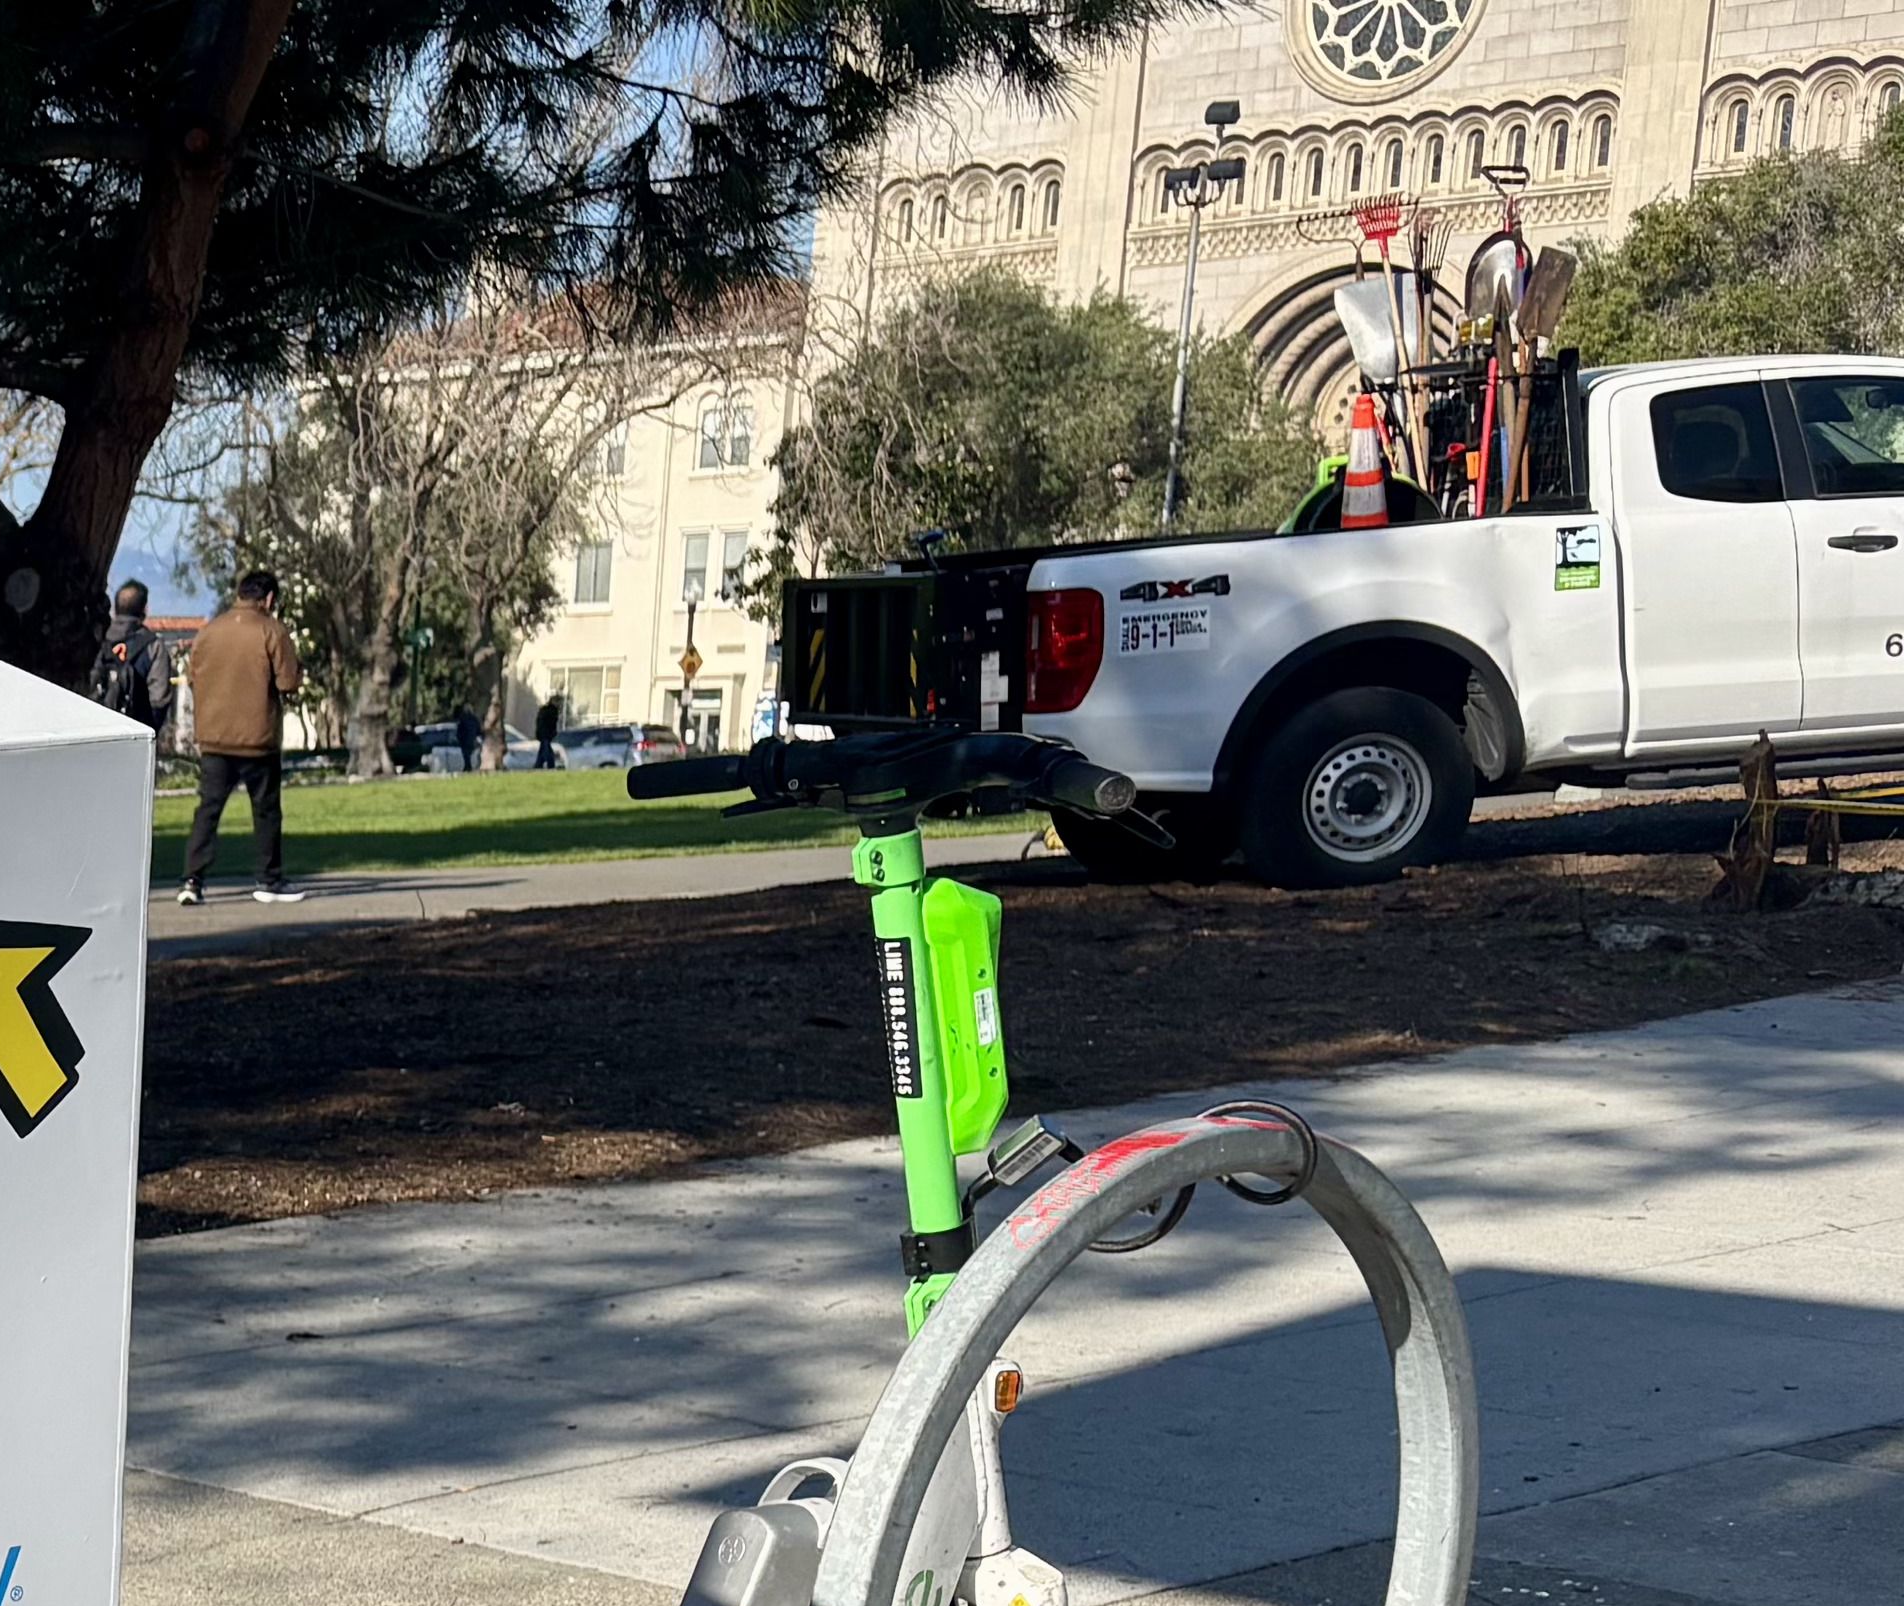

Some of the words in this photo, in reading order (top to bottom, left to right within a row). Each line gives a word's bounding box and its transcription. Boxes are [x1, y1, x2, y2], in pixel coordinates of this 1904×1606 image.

[1131, 622, 1174, 650] 9-1-1
[1885, 633, 1904, 657] 6
[884, 942, 904, 981] LIME
